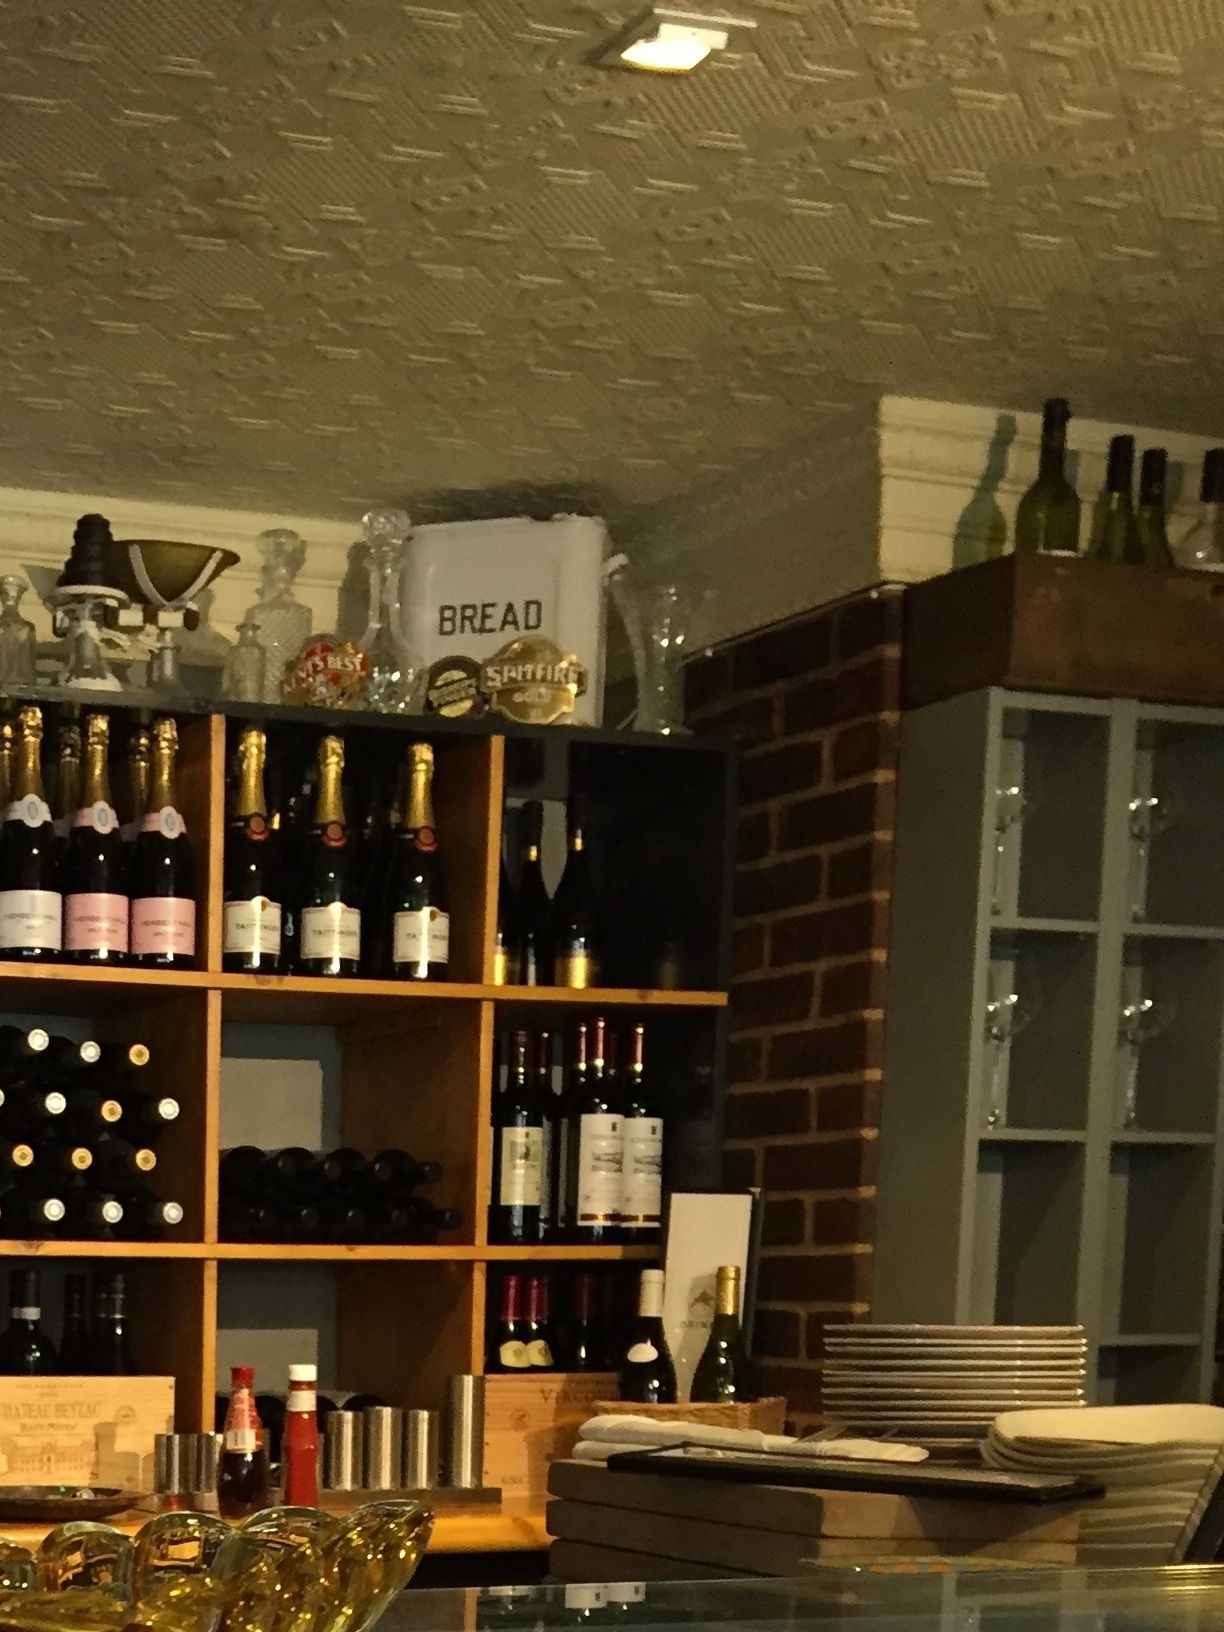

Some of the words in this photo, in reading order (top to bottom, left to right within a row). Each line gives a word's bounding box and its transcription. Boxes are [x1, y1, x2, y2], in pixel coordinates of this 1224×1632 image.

[438, 600, 543, 636] BREAD
[326, 654, 363, 672] BEST
[486, 662, 579, 688] SPITFIRE
